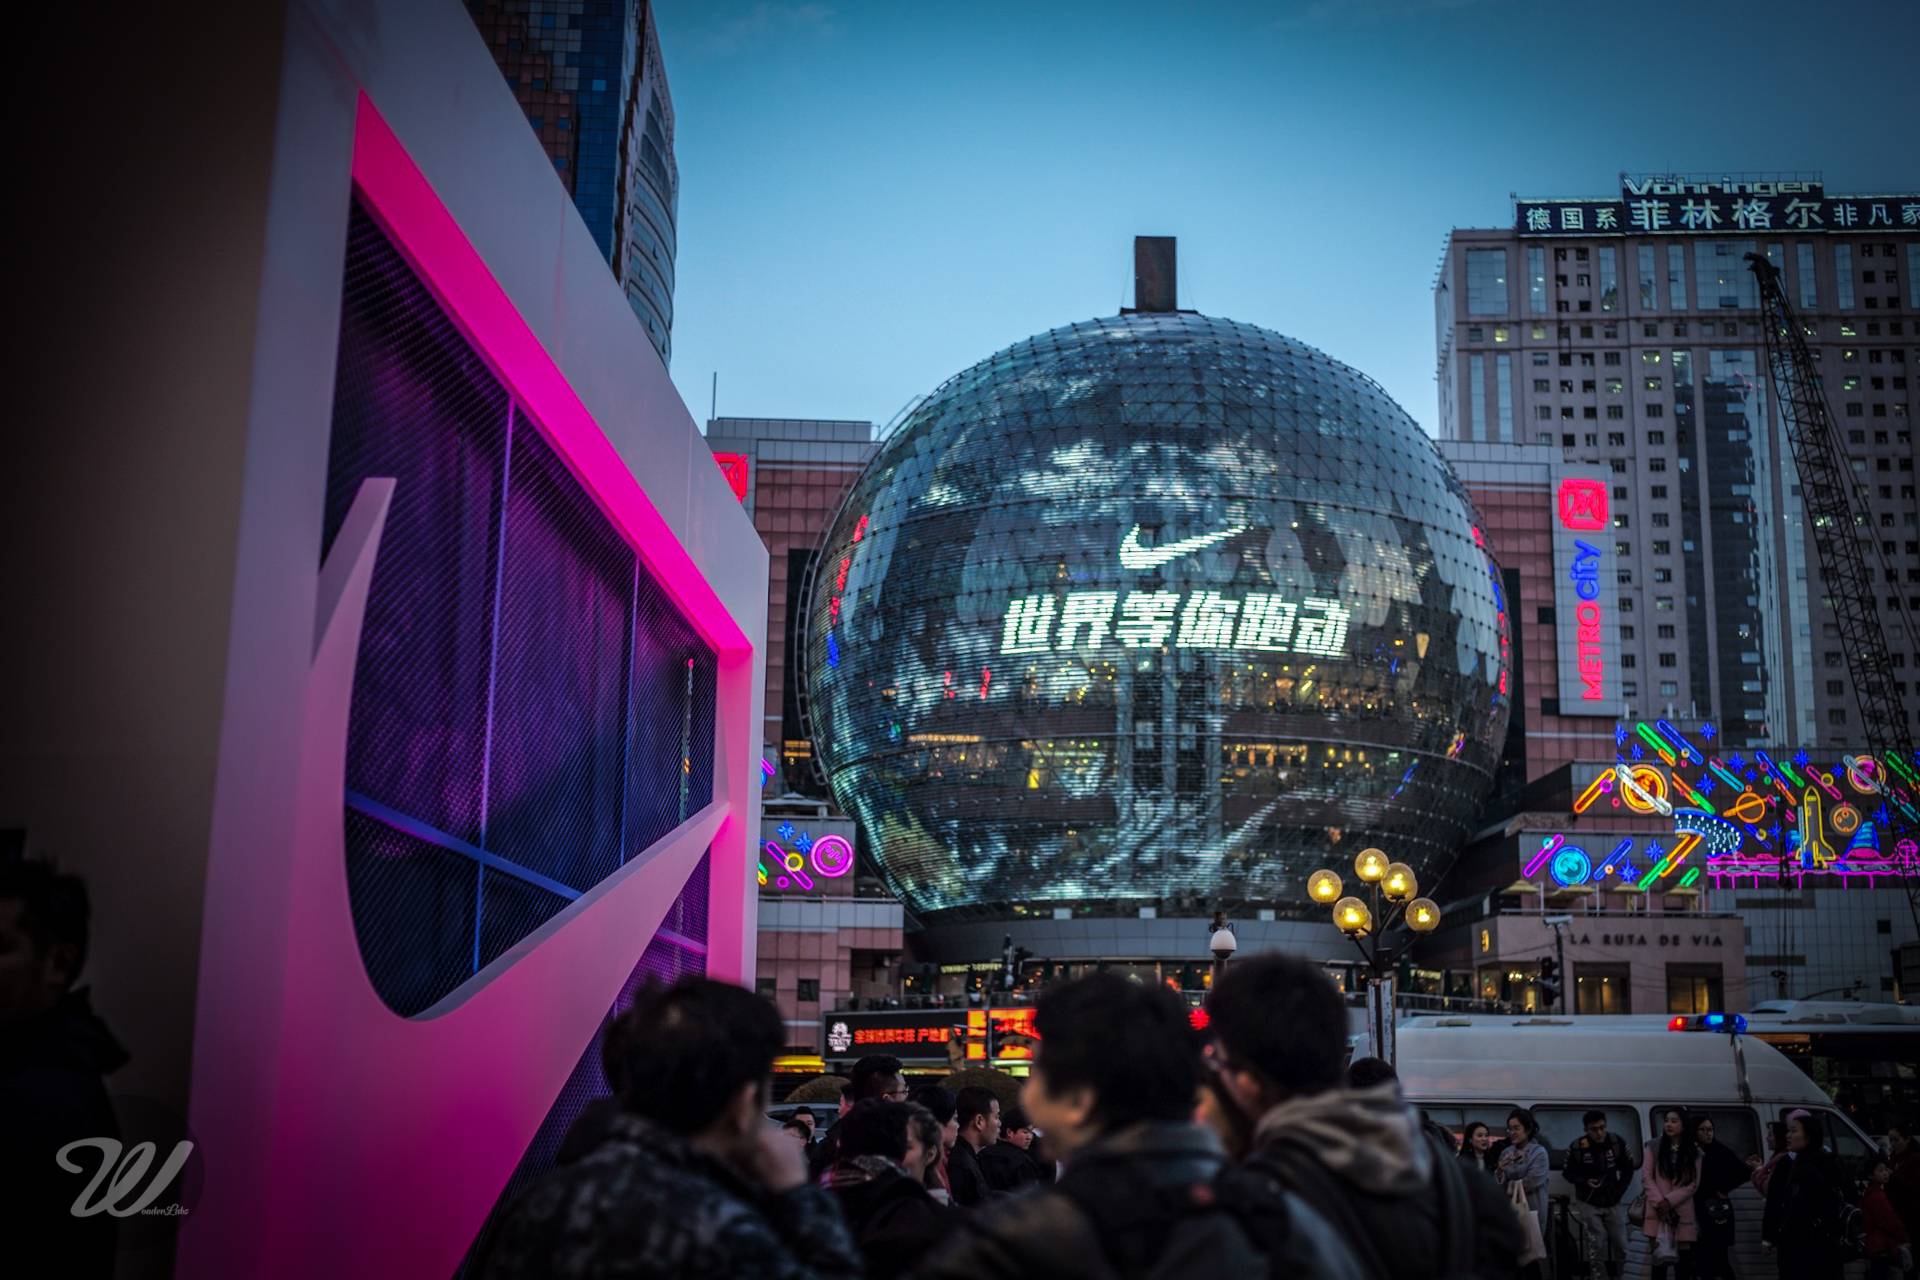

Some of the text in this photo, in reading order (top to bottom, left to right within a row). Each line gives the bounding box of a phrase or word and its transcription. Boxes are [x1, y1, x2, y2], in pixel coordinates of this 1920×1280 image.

[1624, 176, 1823, 197] Vöhringer
[1526, 207, 1617, 231] 德国系
[1630, 198, 1824, 230] 菲林格尔
[1570, 934, 1723, 946] LA RUTA DE VIA
